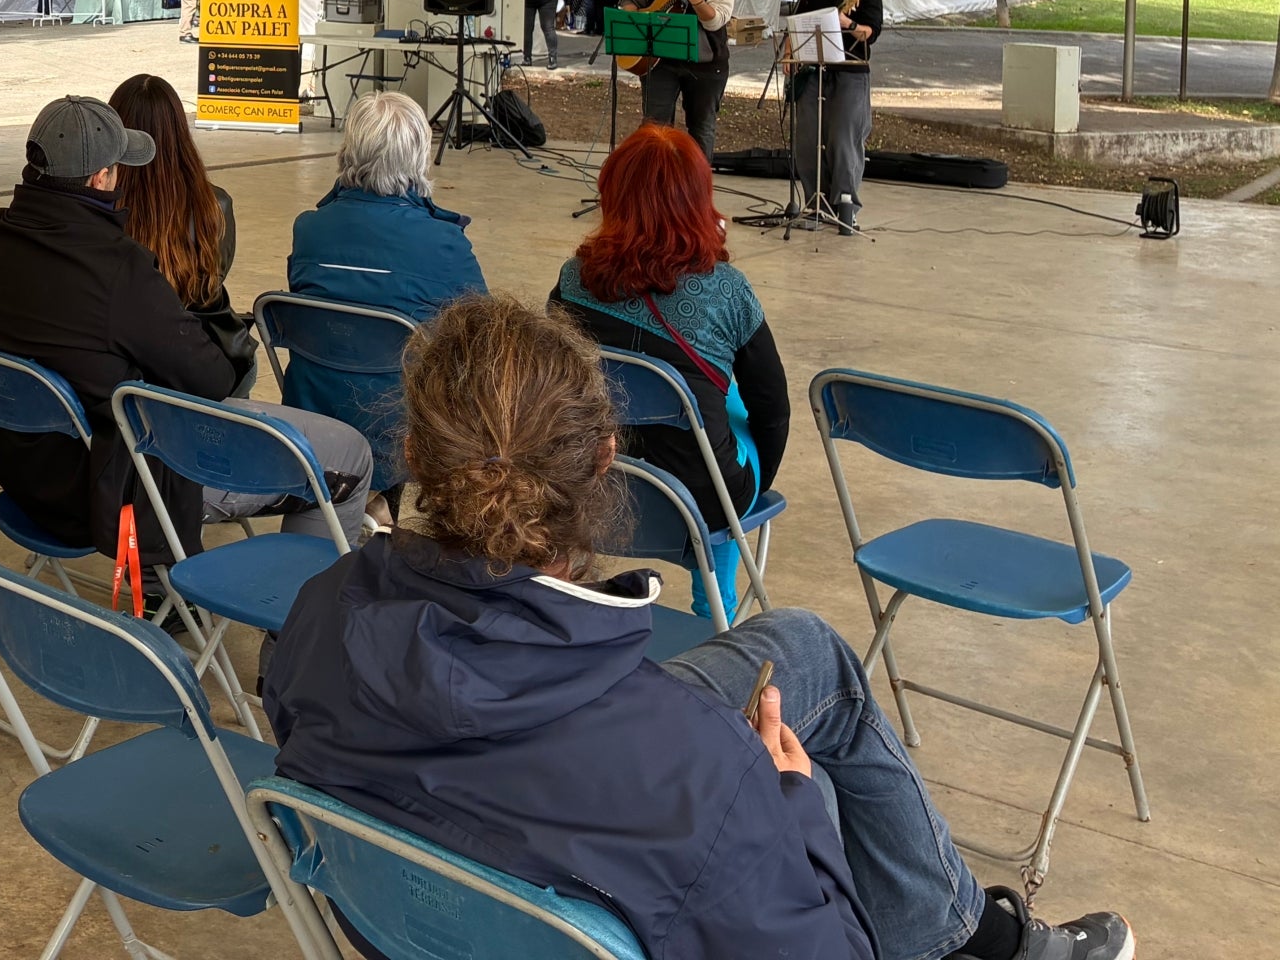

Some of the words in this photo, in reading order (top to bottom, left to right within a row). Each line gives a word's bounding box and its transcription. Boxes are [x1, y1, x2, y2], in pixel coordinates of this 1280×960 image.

[208, 2, 273, 18] COMPRA
[277, 4, 288, 19] A
[206, 20, 237, 35] CAN
[241, 21, 291, 37] PALET
[199, 104, 241, 117] COMERÇ
[243, 106, 265, 117] CAN
[267, 107, 294, 118] PALET
